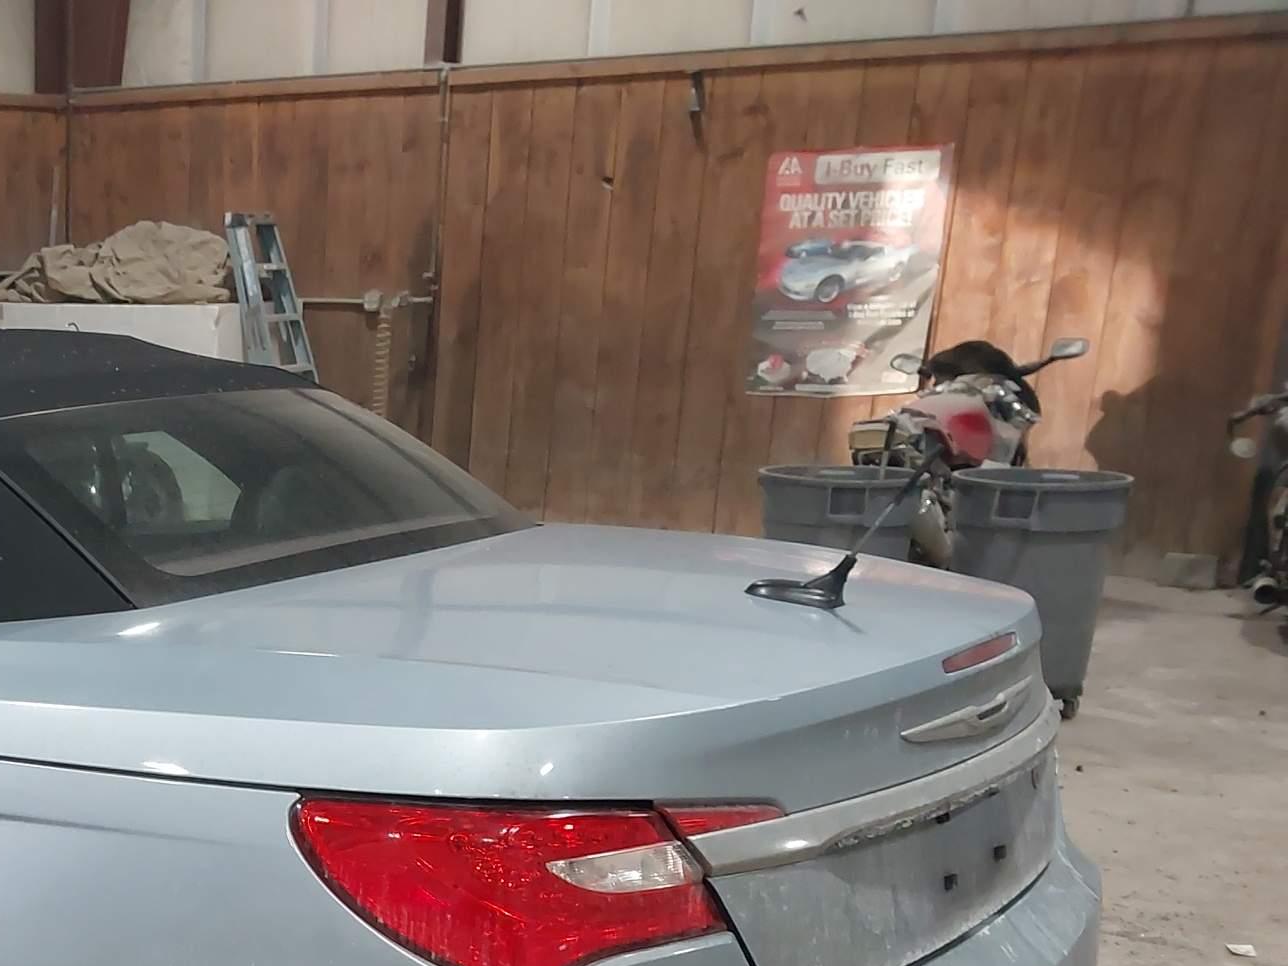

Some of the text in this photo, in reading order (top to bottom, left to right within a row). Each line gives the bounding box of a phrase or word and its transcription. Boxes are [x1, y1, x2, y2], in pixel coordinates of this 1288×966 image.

[883, 157, 925, 174] Fast
[779, 190, 925, 211] QUALITY VEHICLE
[789, 211, 811, 228] AT
[812, 211, 825, 228] A
[827, 210, 858, 228] SET
